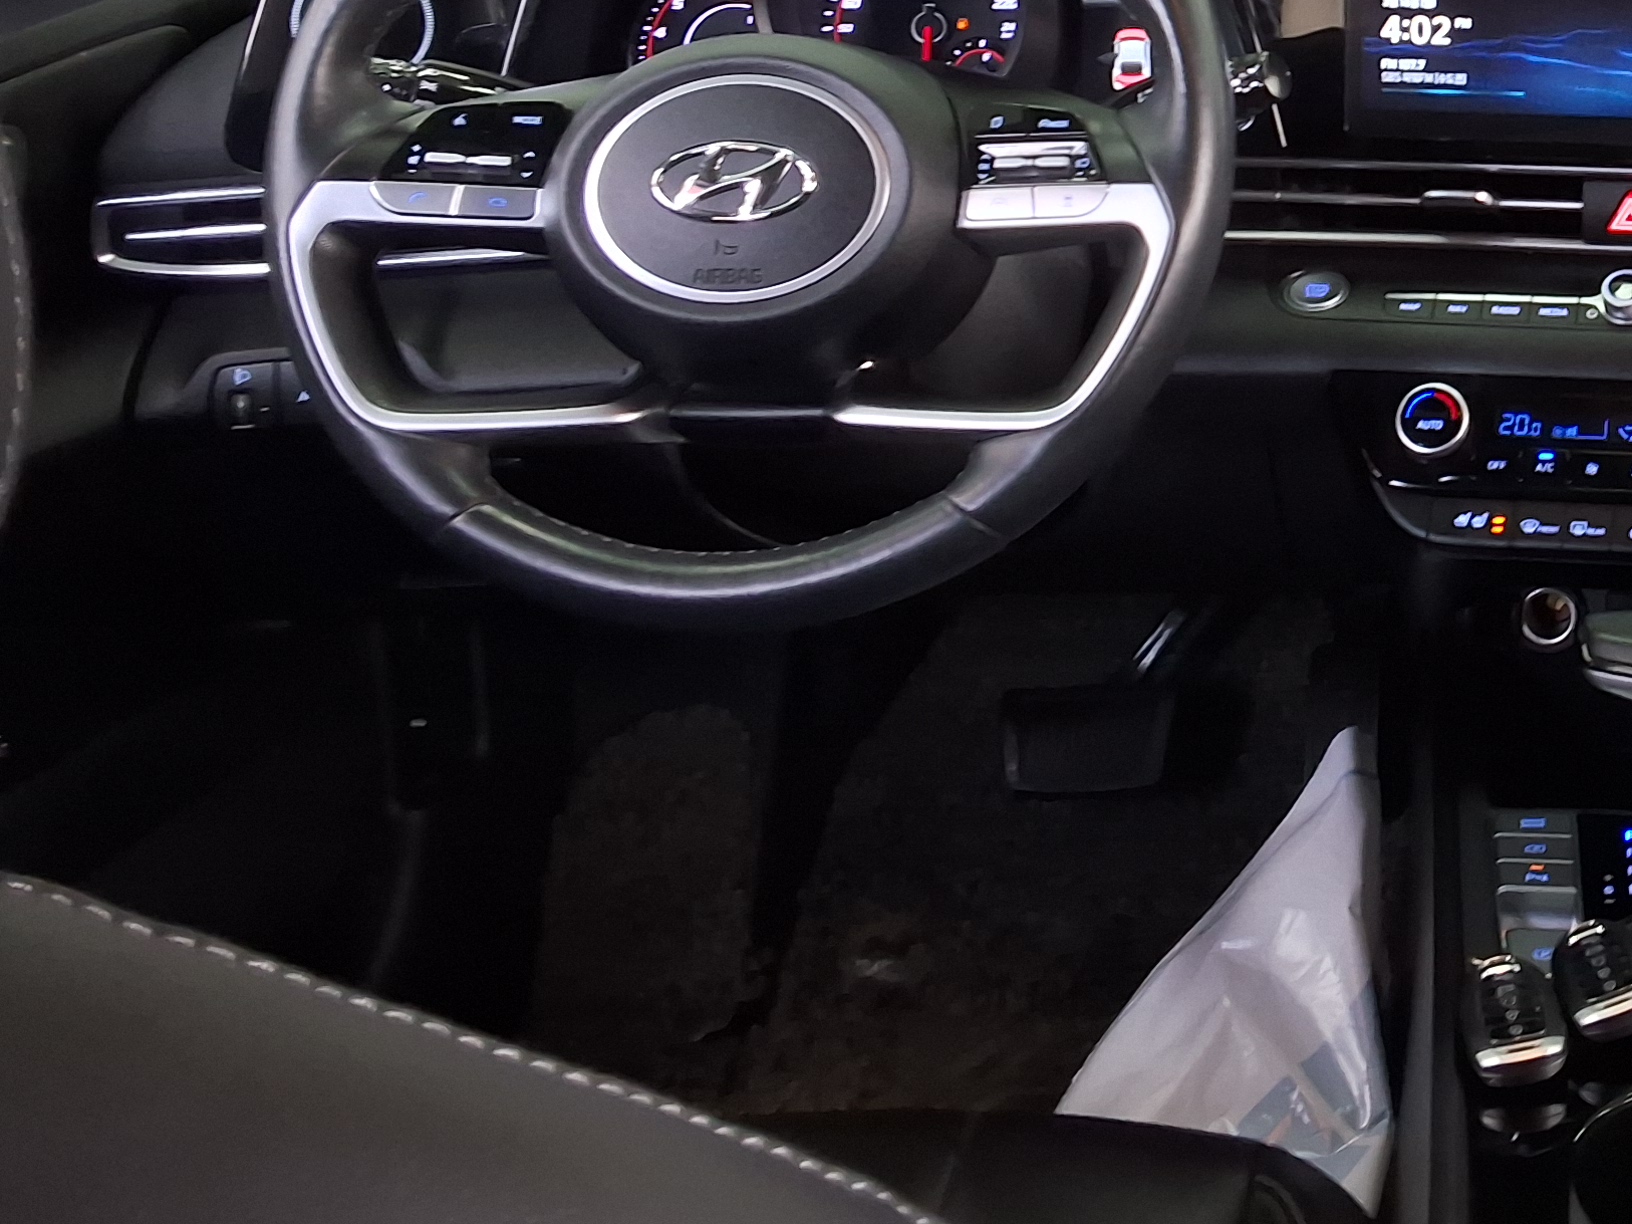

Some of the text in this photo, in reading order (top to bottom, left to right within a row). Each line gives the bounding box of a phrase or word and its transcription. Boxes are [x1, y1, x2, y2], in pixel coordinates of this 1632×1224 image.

[1379, 14, 1452, 46] 4:02
[1416, 420, 1445, 431] AUTO
[1534, 462, 1555, 473] A/C
